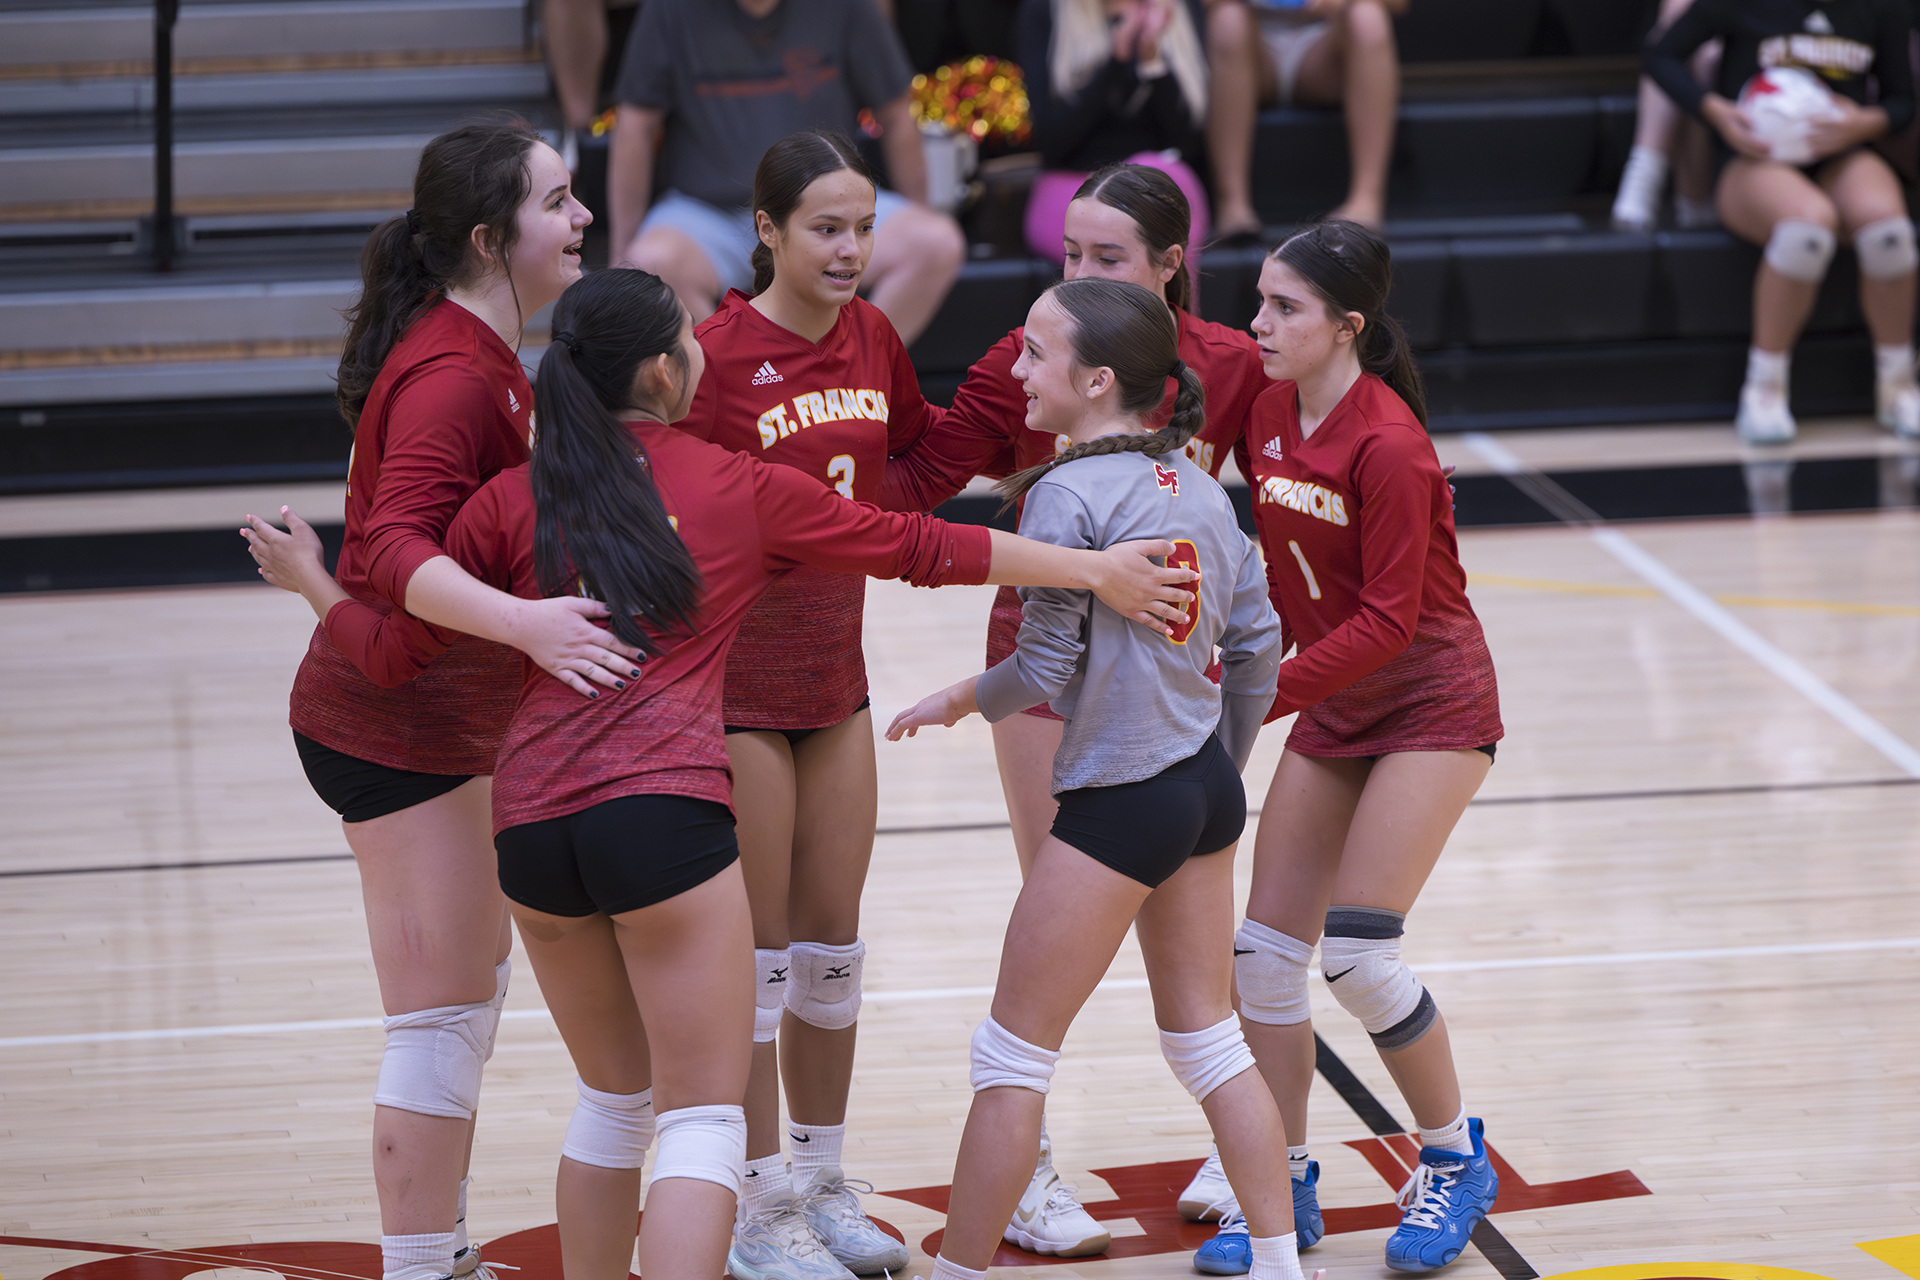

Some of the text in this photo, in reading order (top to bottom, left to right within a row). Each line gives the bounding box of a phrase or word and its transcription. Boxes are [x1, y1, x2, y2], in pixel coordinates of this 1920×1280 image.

[752, 373, 784, 386] adidas
[757, 388, 889, 450] ST. FRANCIS
[827, 454, 856, 501] 3
[1264, 476, 1349, 527] FRANCIS
[1288, 539, 1322, 600] 1
